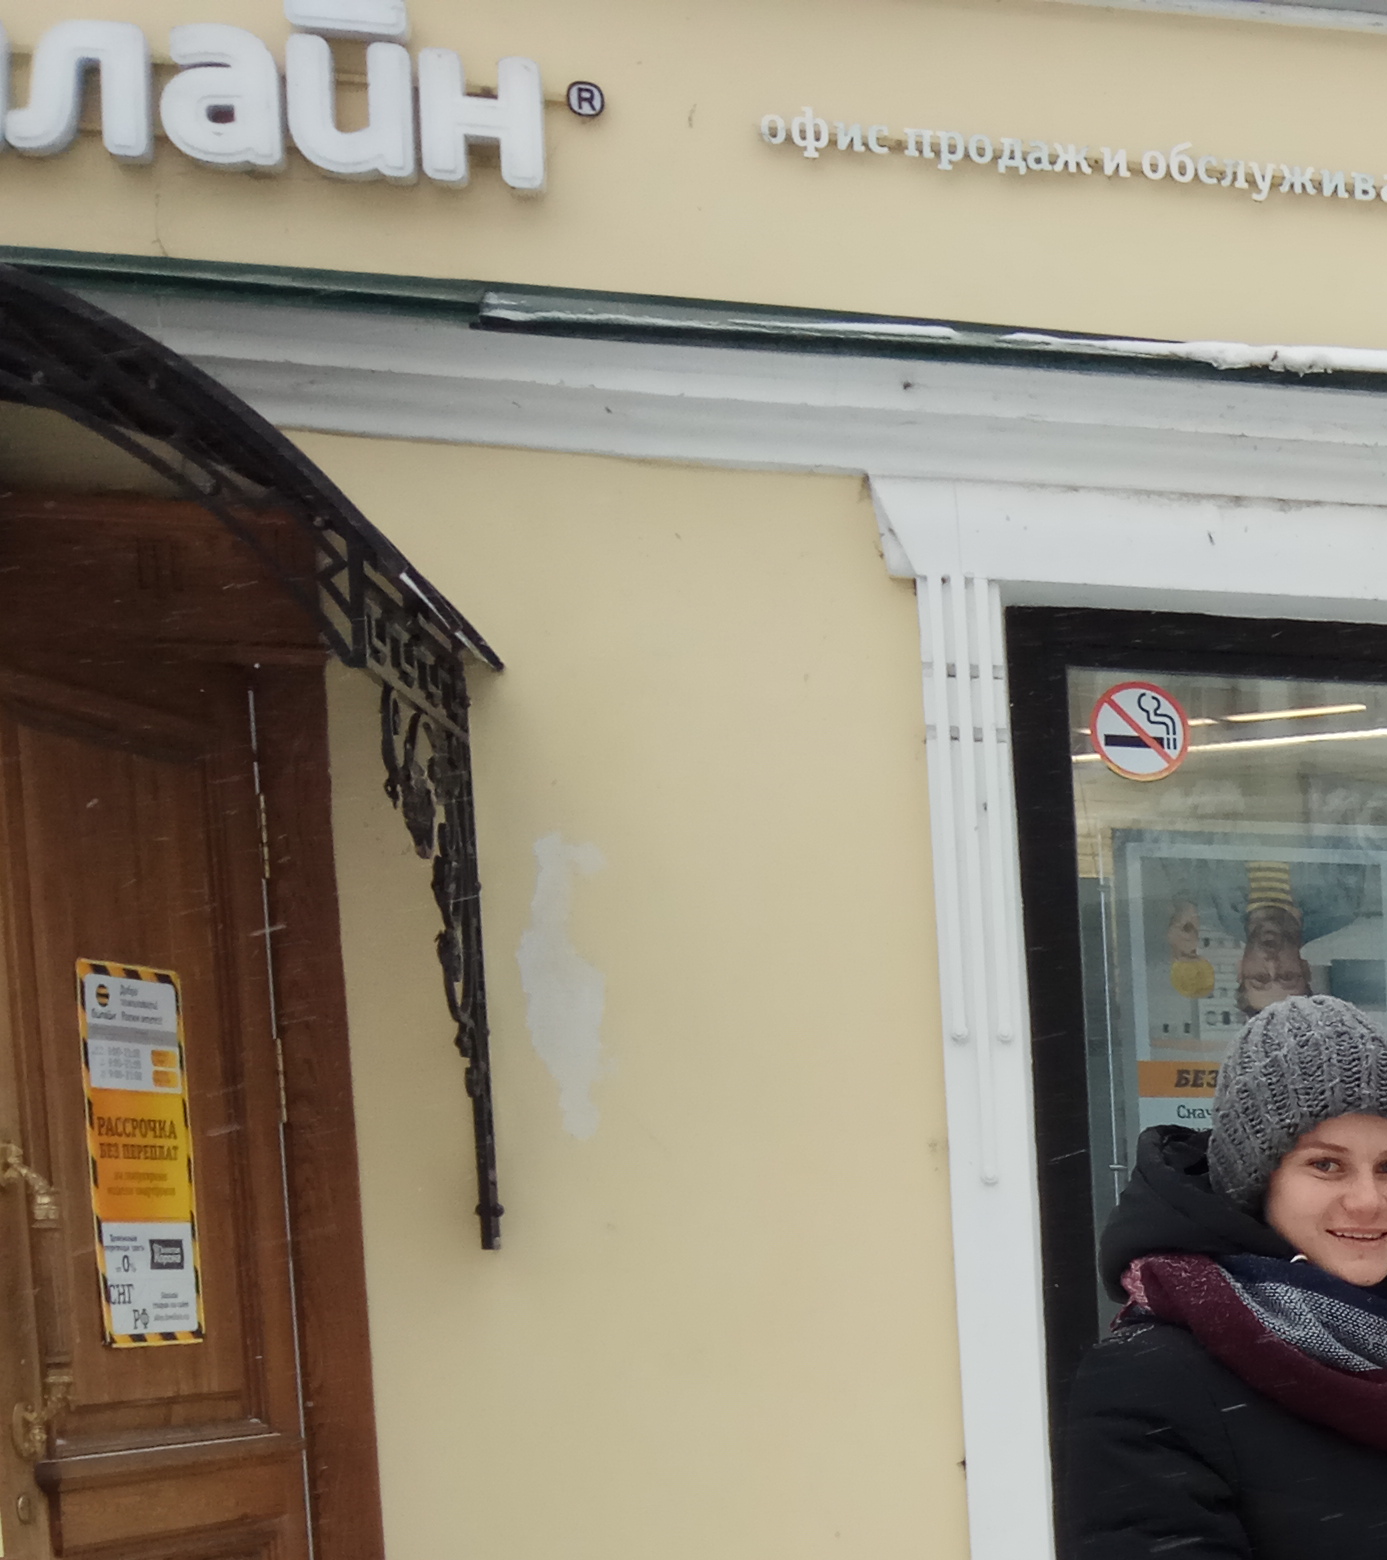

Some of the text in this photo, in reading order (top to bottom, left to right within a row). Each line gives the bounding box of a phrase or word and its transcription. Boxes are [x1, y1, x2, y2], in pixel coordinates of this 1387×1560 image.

[0, 0, 542, 190] лайн
[759, 106, 889, 159] офис
[904, 126, 1092, 175] продаж
[1101, 145, 1131, 178] и
[97, 1116, 177, 1140] РАССРОЧКА
[99, 1142, 119, 1159] БЕЗ
[108, 1284, 135, 1305] СНГ
[132, 1308, 150, 1330] РФ
